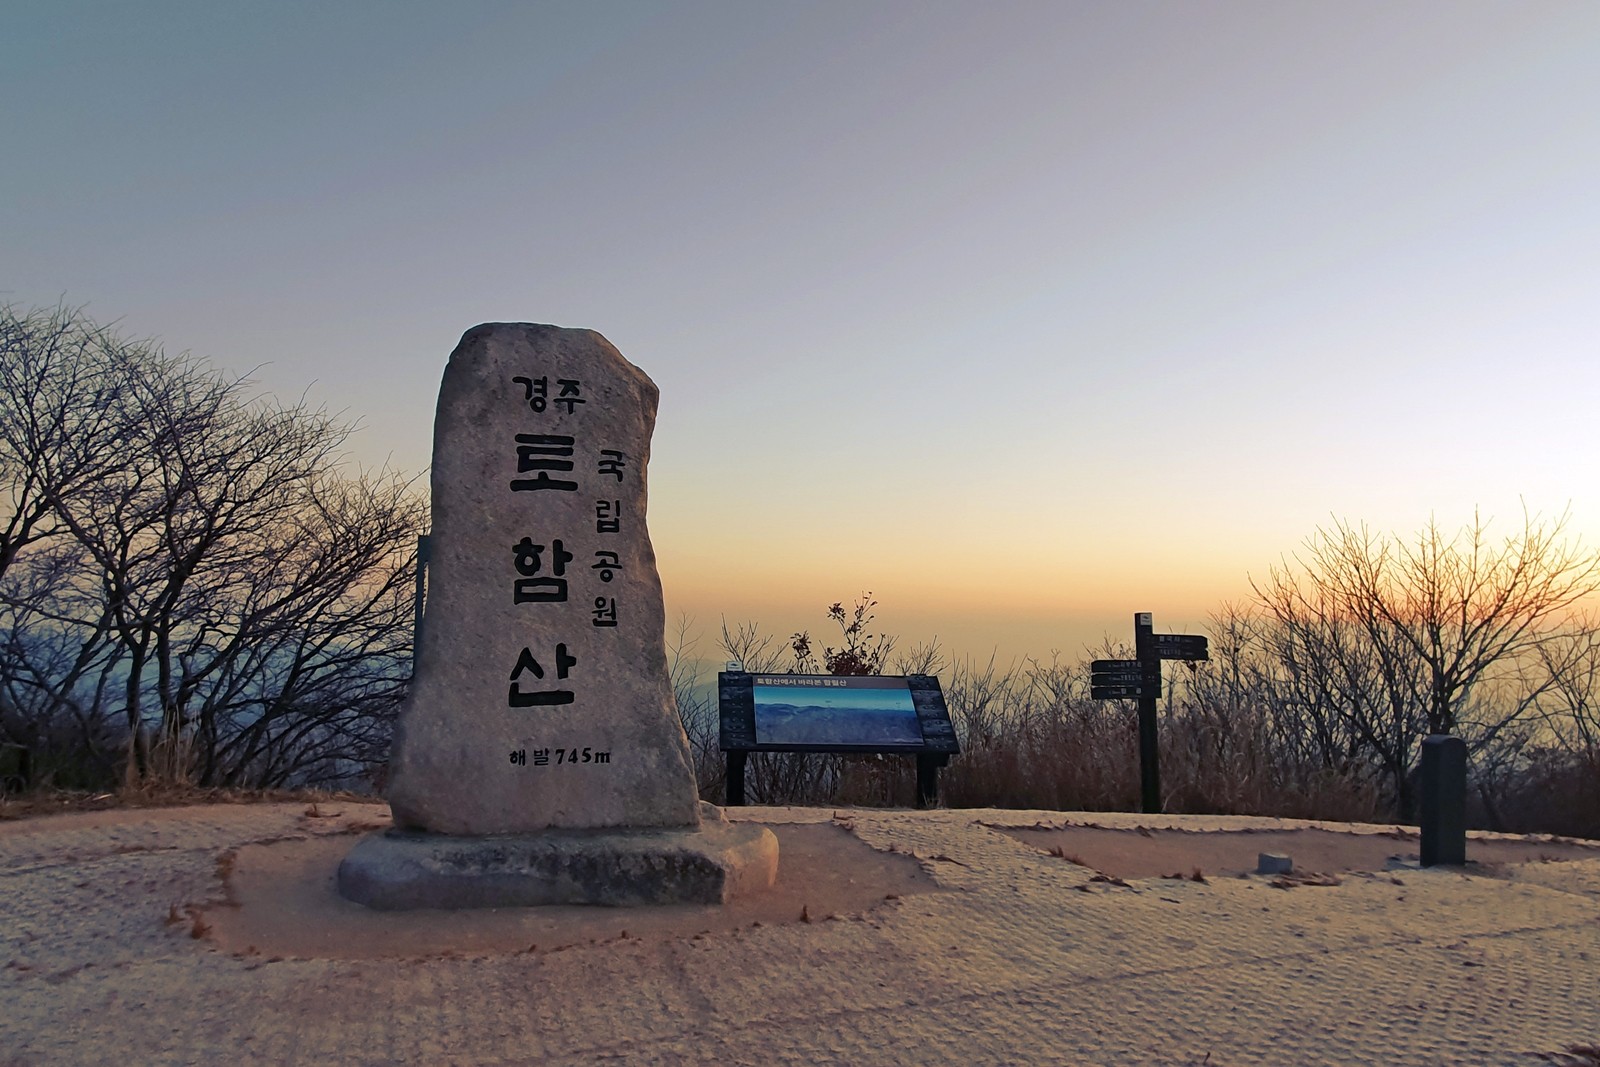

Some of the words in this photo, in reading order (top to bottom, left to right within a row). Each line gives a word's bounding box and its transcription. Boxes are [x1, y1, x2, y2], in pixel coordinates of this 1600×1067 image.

[512, 376, 586, 415] 경주
[508, 433, 578, 708] 토함산
[591, 449, 625, 627] 국립공원
[555, 747, 611, 765] 745m
